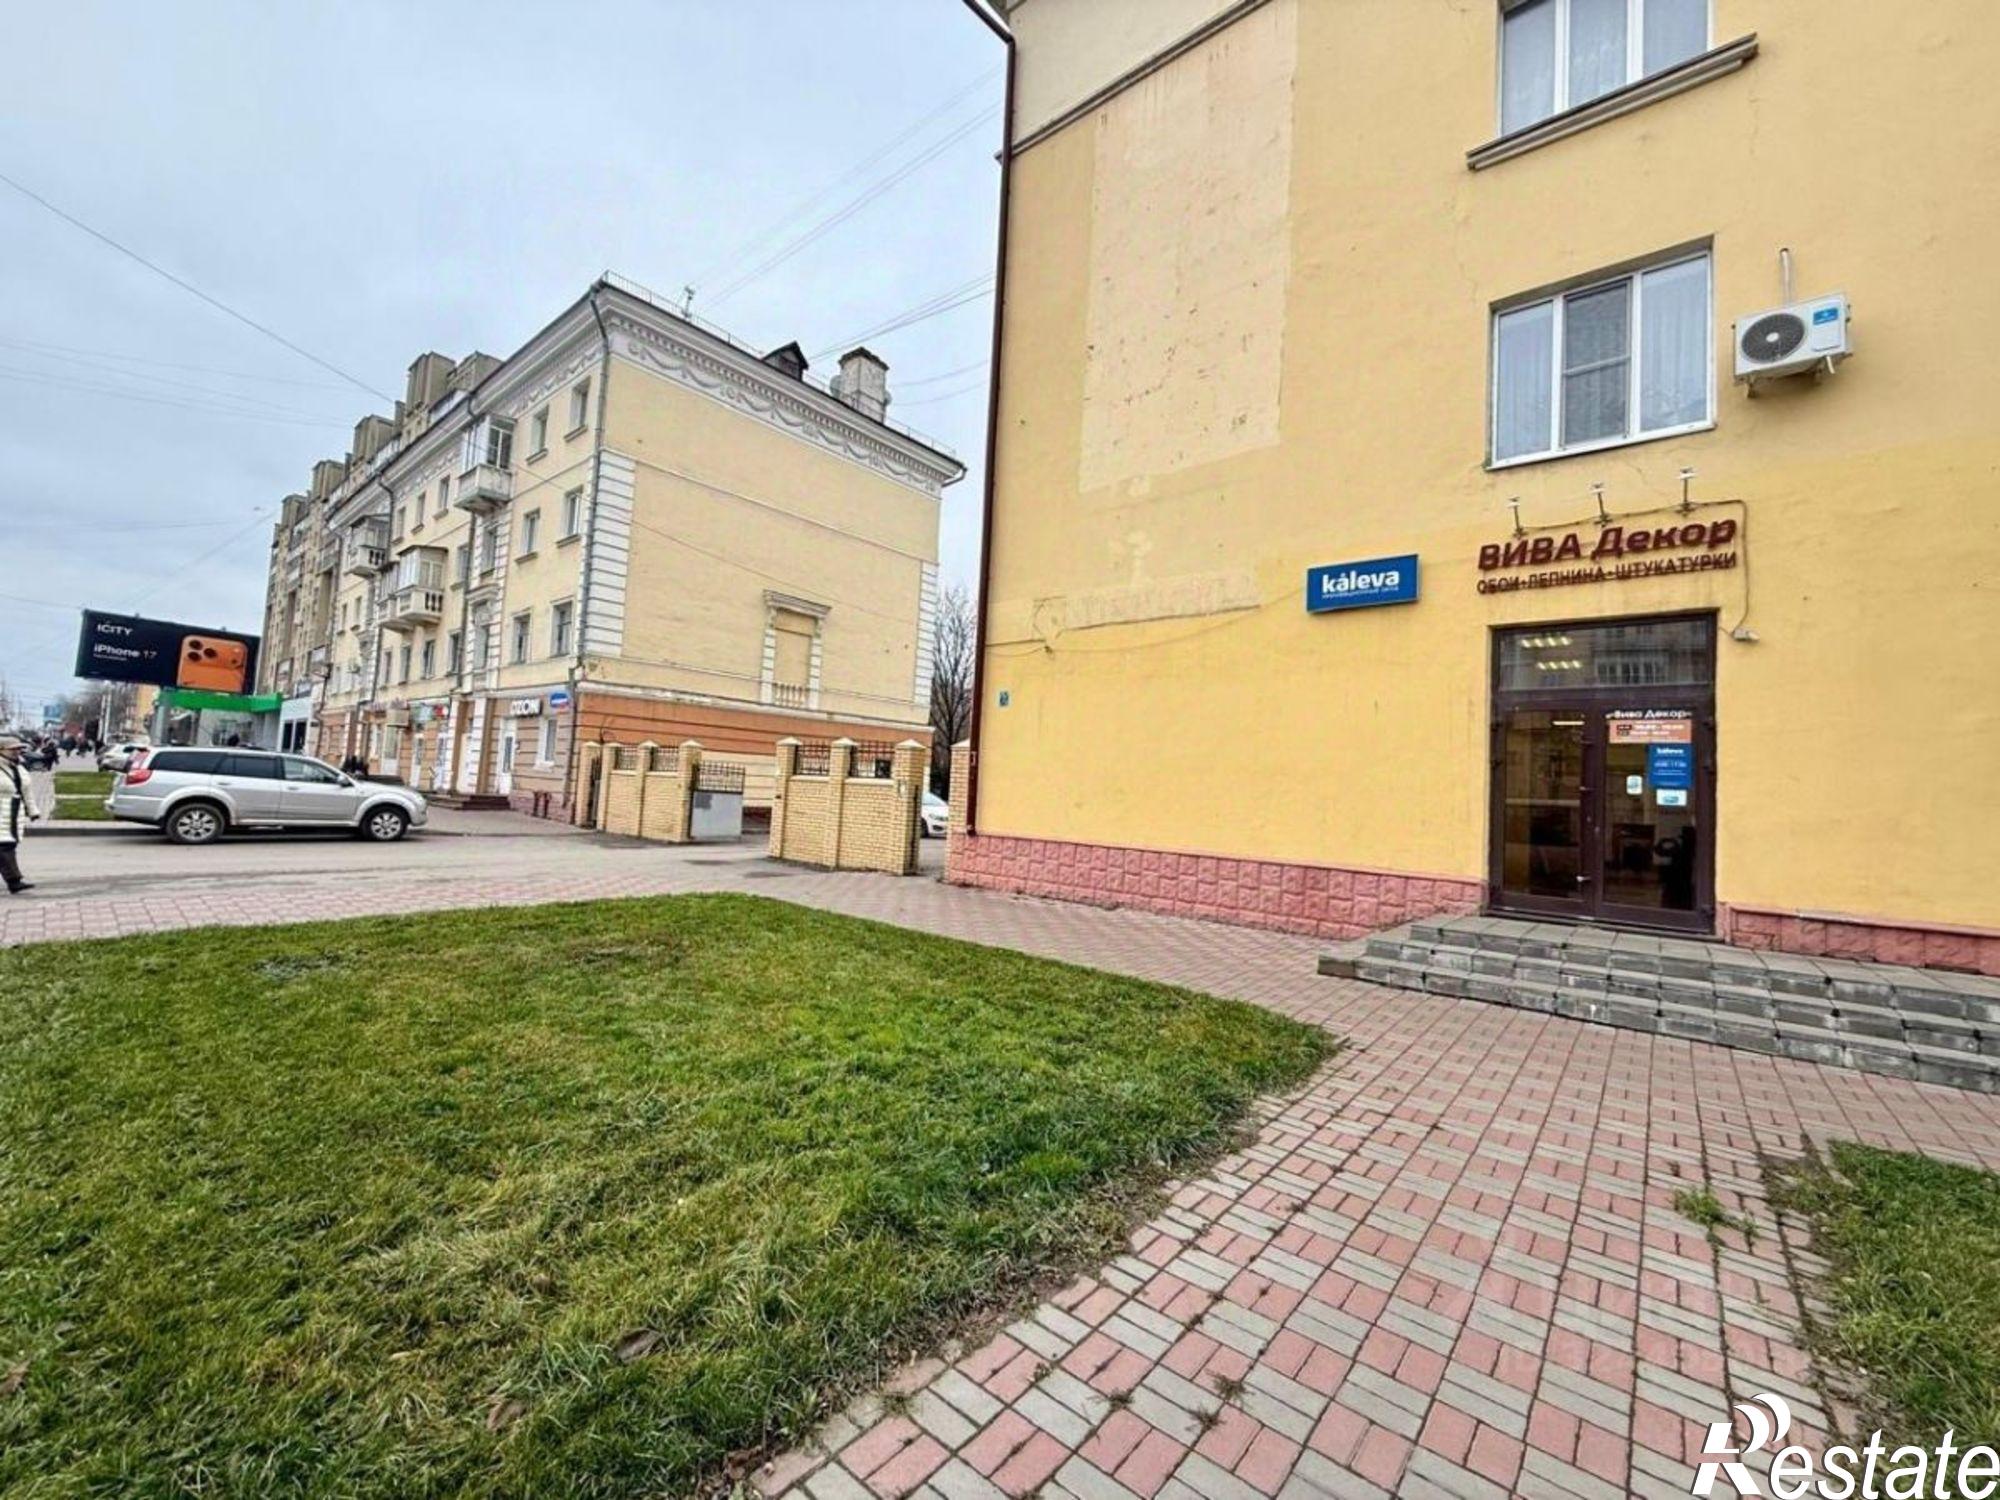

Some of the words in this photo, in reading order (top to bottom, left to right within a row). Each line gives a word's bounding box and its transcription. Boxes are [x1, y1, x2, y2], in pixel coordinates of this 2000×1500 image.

[1478, 532, 1581, 571] ВИВА
[1591, 519, 1737, 561] Декор
[94, 643, 141, 658] iPhone
[143, 650, 157, 660] 17
